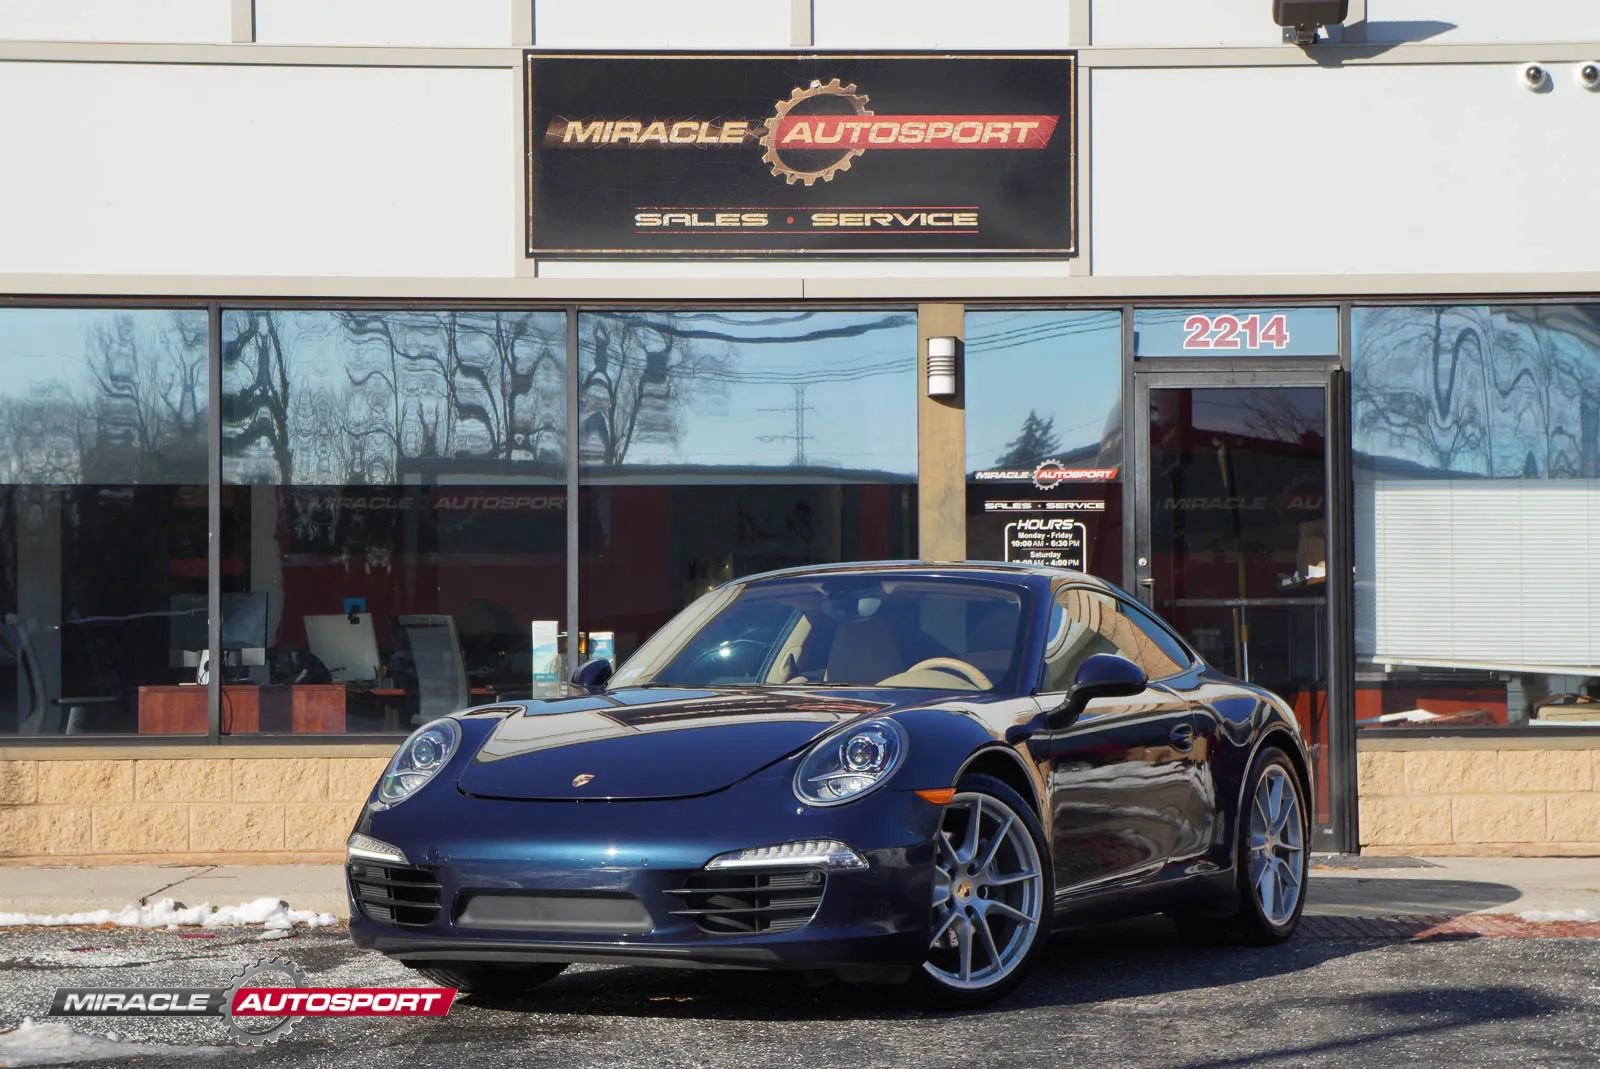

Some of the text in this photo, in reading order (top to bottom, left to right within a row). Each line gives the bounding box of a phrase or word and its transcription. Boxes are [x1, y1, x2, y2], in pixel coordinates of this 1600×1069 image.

[563, 121, 1040, 144] MIRACLE AUTOSPORT
[634, 213, 979, 227] SALES SERVICE
[1183, 314, 1289, 349] 2214
[975, 470, 1112, 480] MIRACLE AUTOSPORT
[433, 497, 567, 509] AUTOSPOR
[1017, 519, 1074, 530] HOURS
[1030, 551, 1061, 559] Saturday
